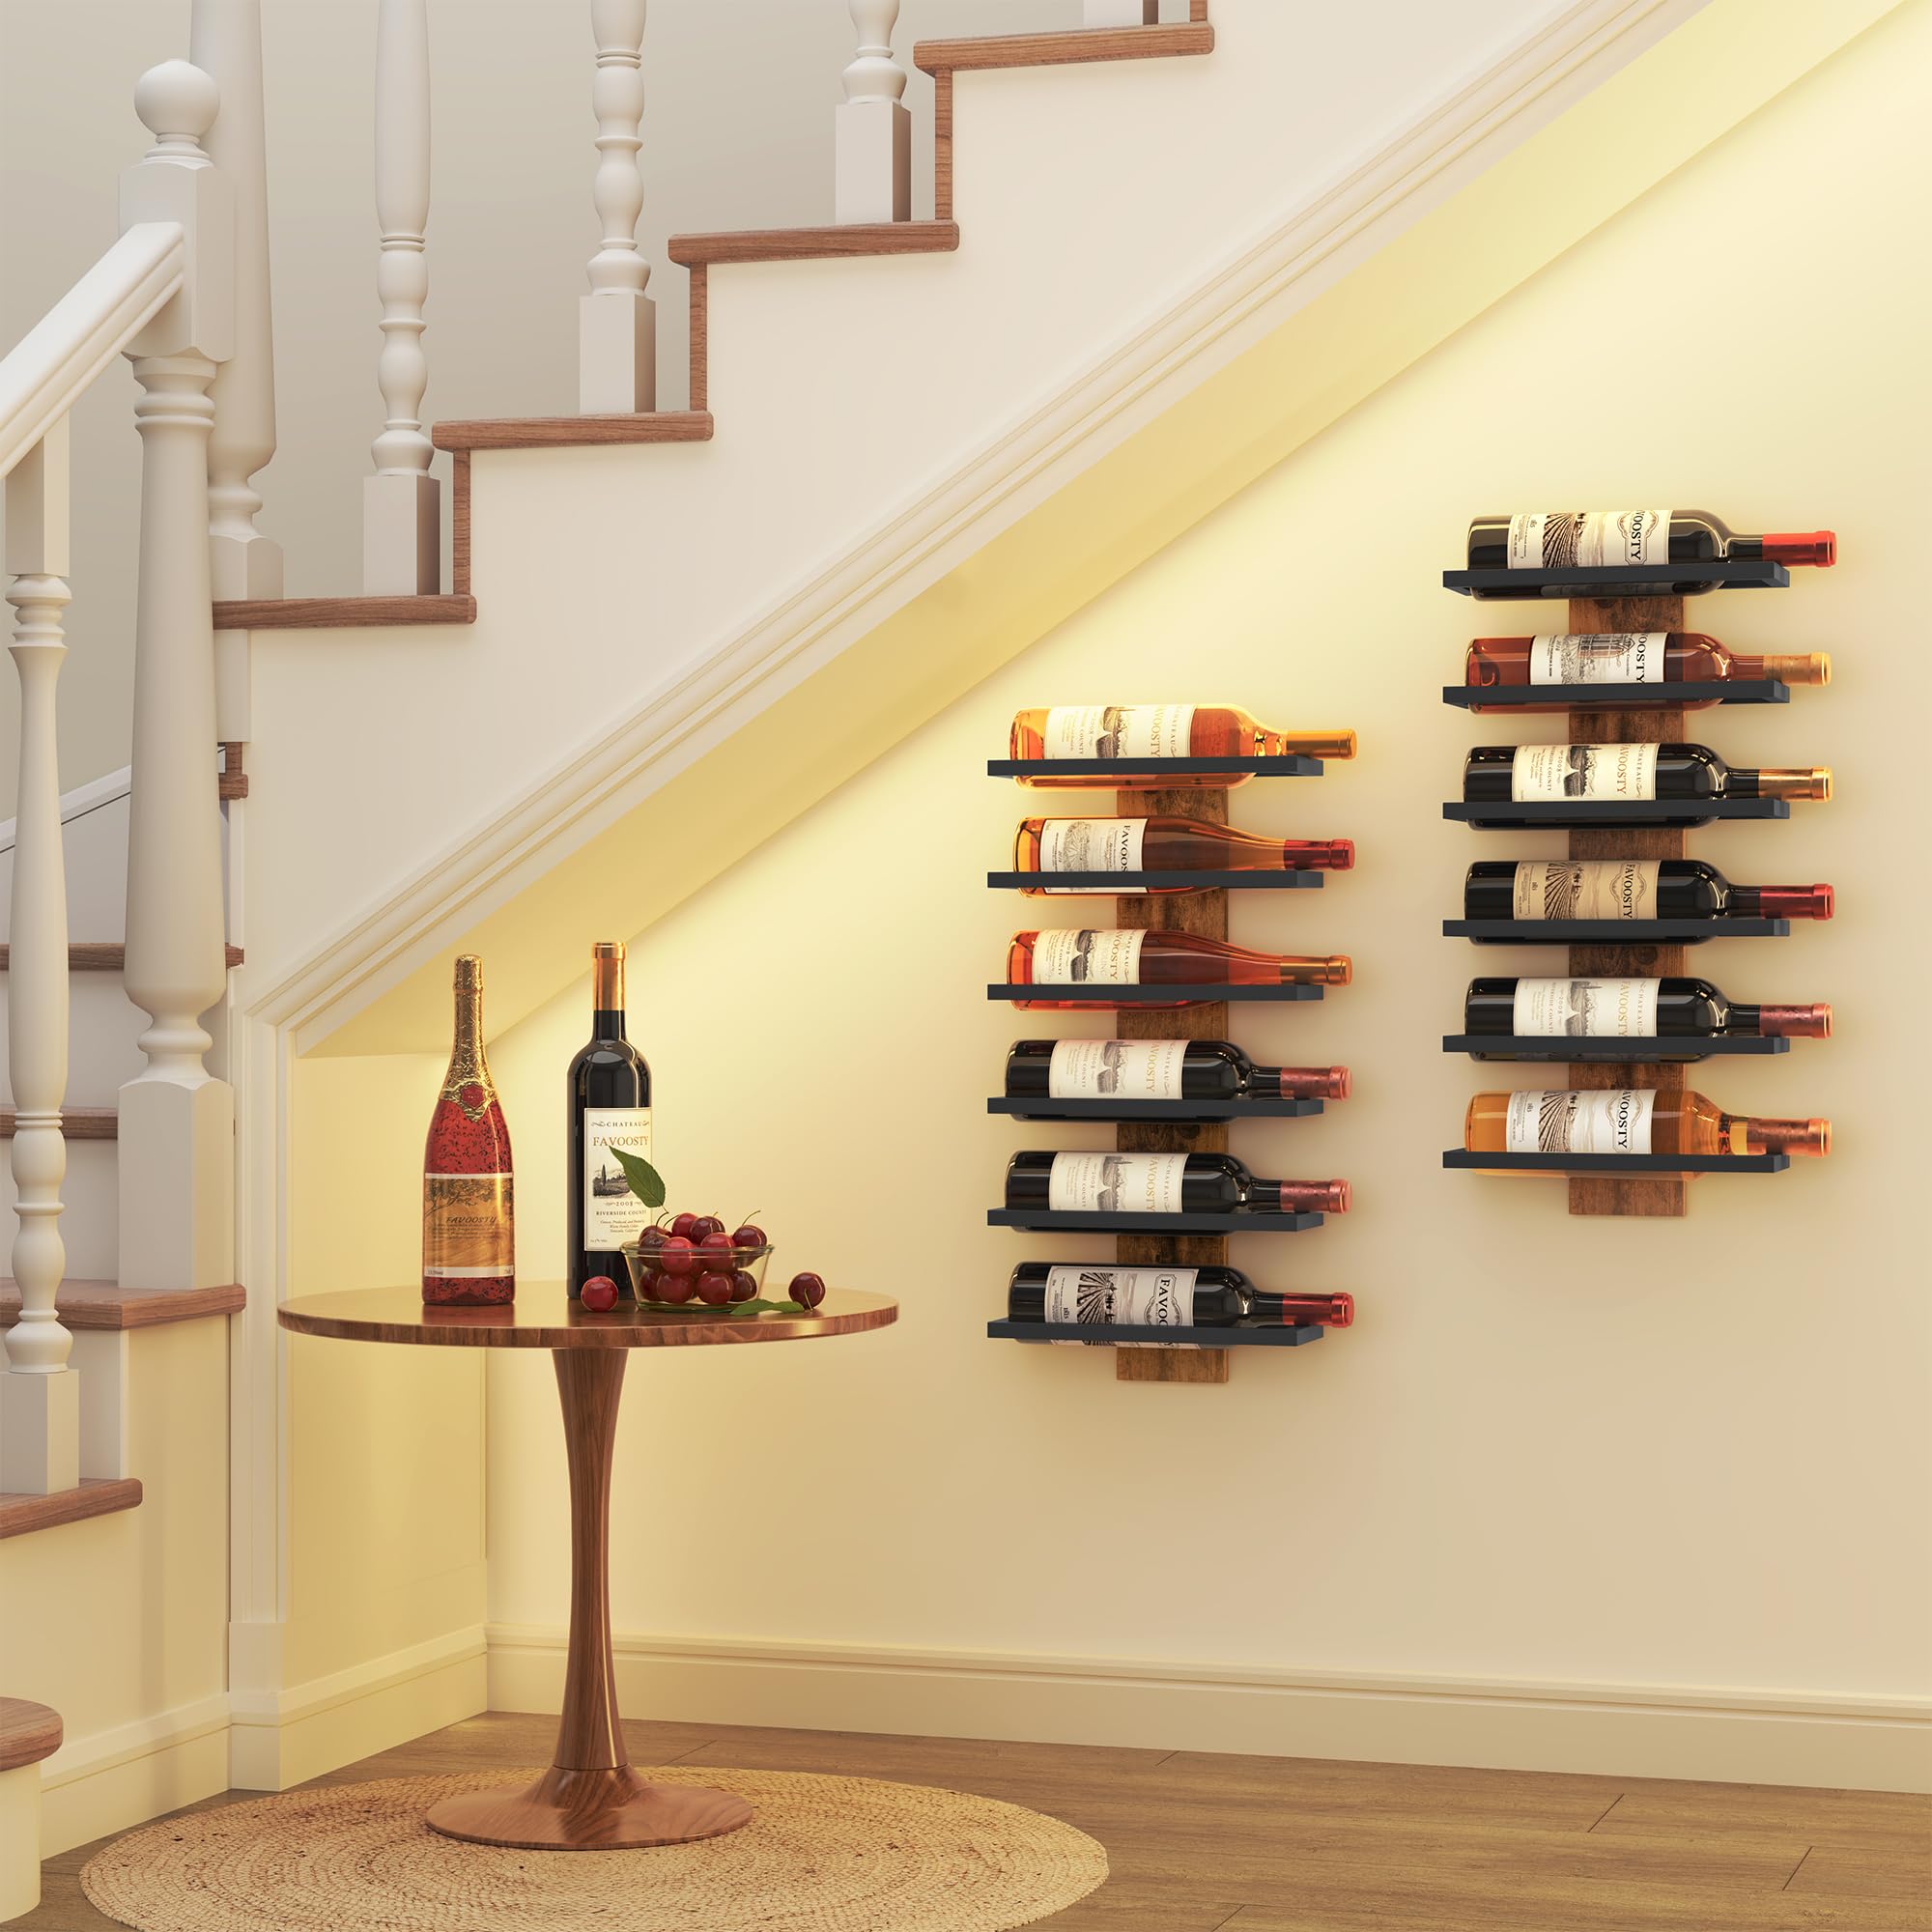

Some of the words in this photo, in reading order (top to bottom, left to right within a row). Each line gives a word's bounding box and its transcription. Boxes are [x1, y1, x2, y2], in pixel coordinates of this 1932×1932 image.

[1622, 865, 1636, 920] FAVOOSTY
[1618, 981, 1632, 1036] FAVOOSTY
[592, 1136, 649, 1147] FAVOOSTY
